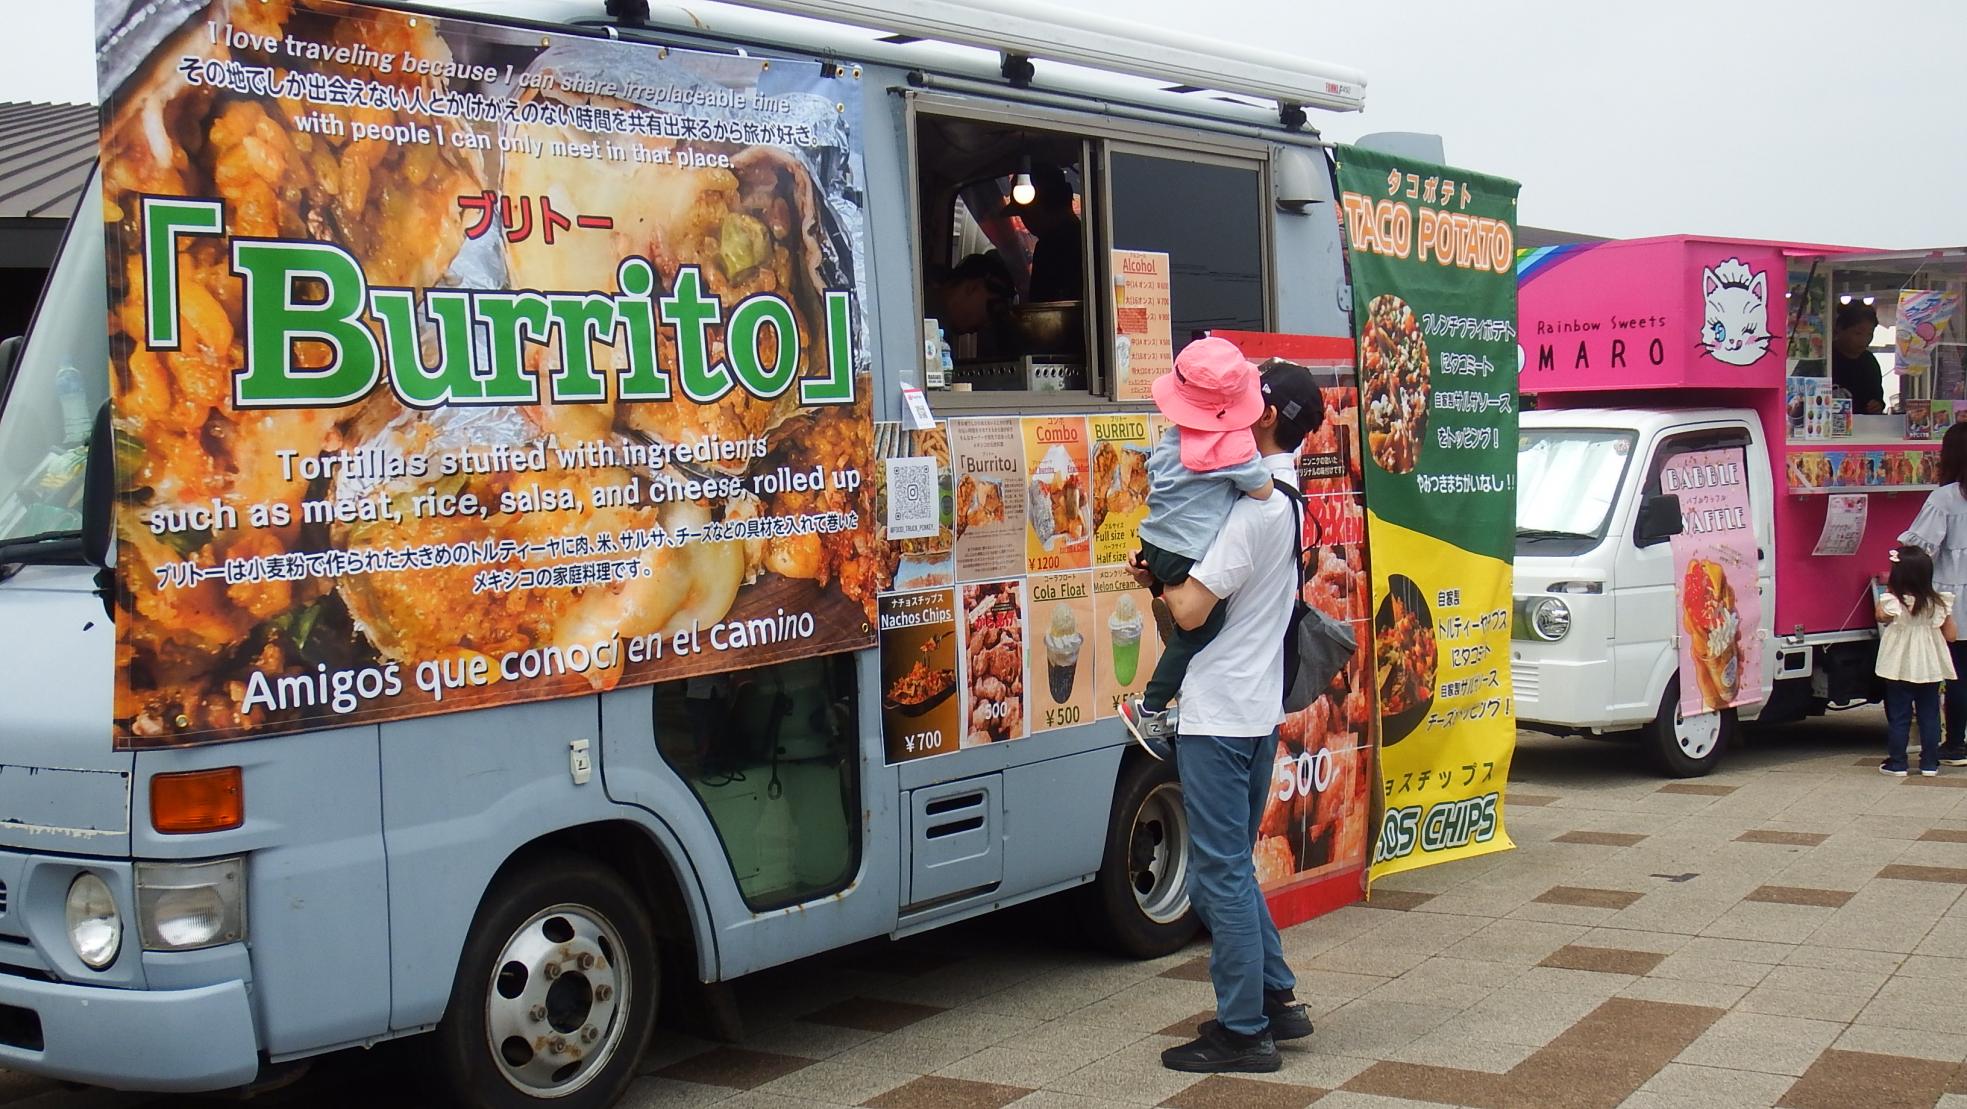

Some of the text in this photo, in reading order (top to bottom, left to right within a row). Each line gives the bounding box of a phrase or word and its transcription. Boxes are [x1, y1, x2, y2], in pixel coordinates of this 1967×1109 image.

[207, 20, 791, 114] I love traveling because I can share irreplaceable time
[177, 57, 819, 148] その地でしか出会えない人とかけがえのない時間を共有出来るから旅が好き。
[294, 113, 735, 170] with people I can only meet in that place.
[1388, 168, 1472, 209] タコポテト
[459, 190, 614, 245] ブリトー
[1343, 191, 1513, 274] TACO POTATO
[1123, 258, 1156, 273] Alcohol
[1422, 313, 1516, 342] フレンチフライポテト
[1537, 315, 1667, 335] Rainbow Sweets
[1441, 352, 1494, 376] にタコミート
[1538, 338, 1664, 371] MARO
[1036, 425, 1078, 441] Combo
[1095, 422, 1145, 438] BURRITO
[276, 436, 768, 481] Tortillas stuffed with ingredients
[150, 465, 861, 534] such as meat, rice, salsa, and cheese, rolled up
[1095, 531, 1110, 541] Full
[1111, 530, 1125, 540] size
[155, 512, 859, 590] ブリトーは小麦粉で作られた大きめのトルティーヤに肉、米、サルサ、チーズなどの具材を入れて巻いた
[1097, 552, 1126, 564] Half size
[472, 558, 653, 593] メキシコの家庭料理です。
[1094, 579, 1136, 592] Melon Cream
[892, 593, 943, 608] ナチョスチップス
[1033, 581, 1086, 600] Cola Float
[1438, 590, 1460, 607] 自家製
[881, 611, 920, 628] Nachos
[923, 607, 951, 624] Chips
[241, 607, 815, 715] Amigos que conocí en el camino
[1046, 705, 1080, 727] ¥500
[904, 730, 942, 752] ¥700
[1421, 792, 1499, 852] CHIPS
